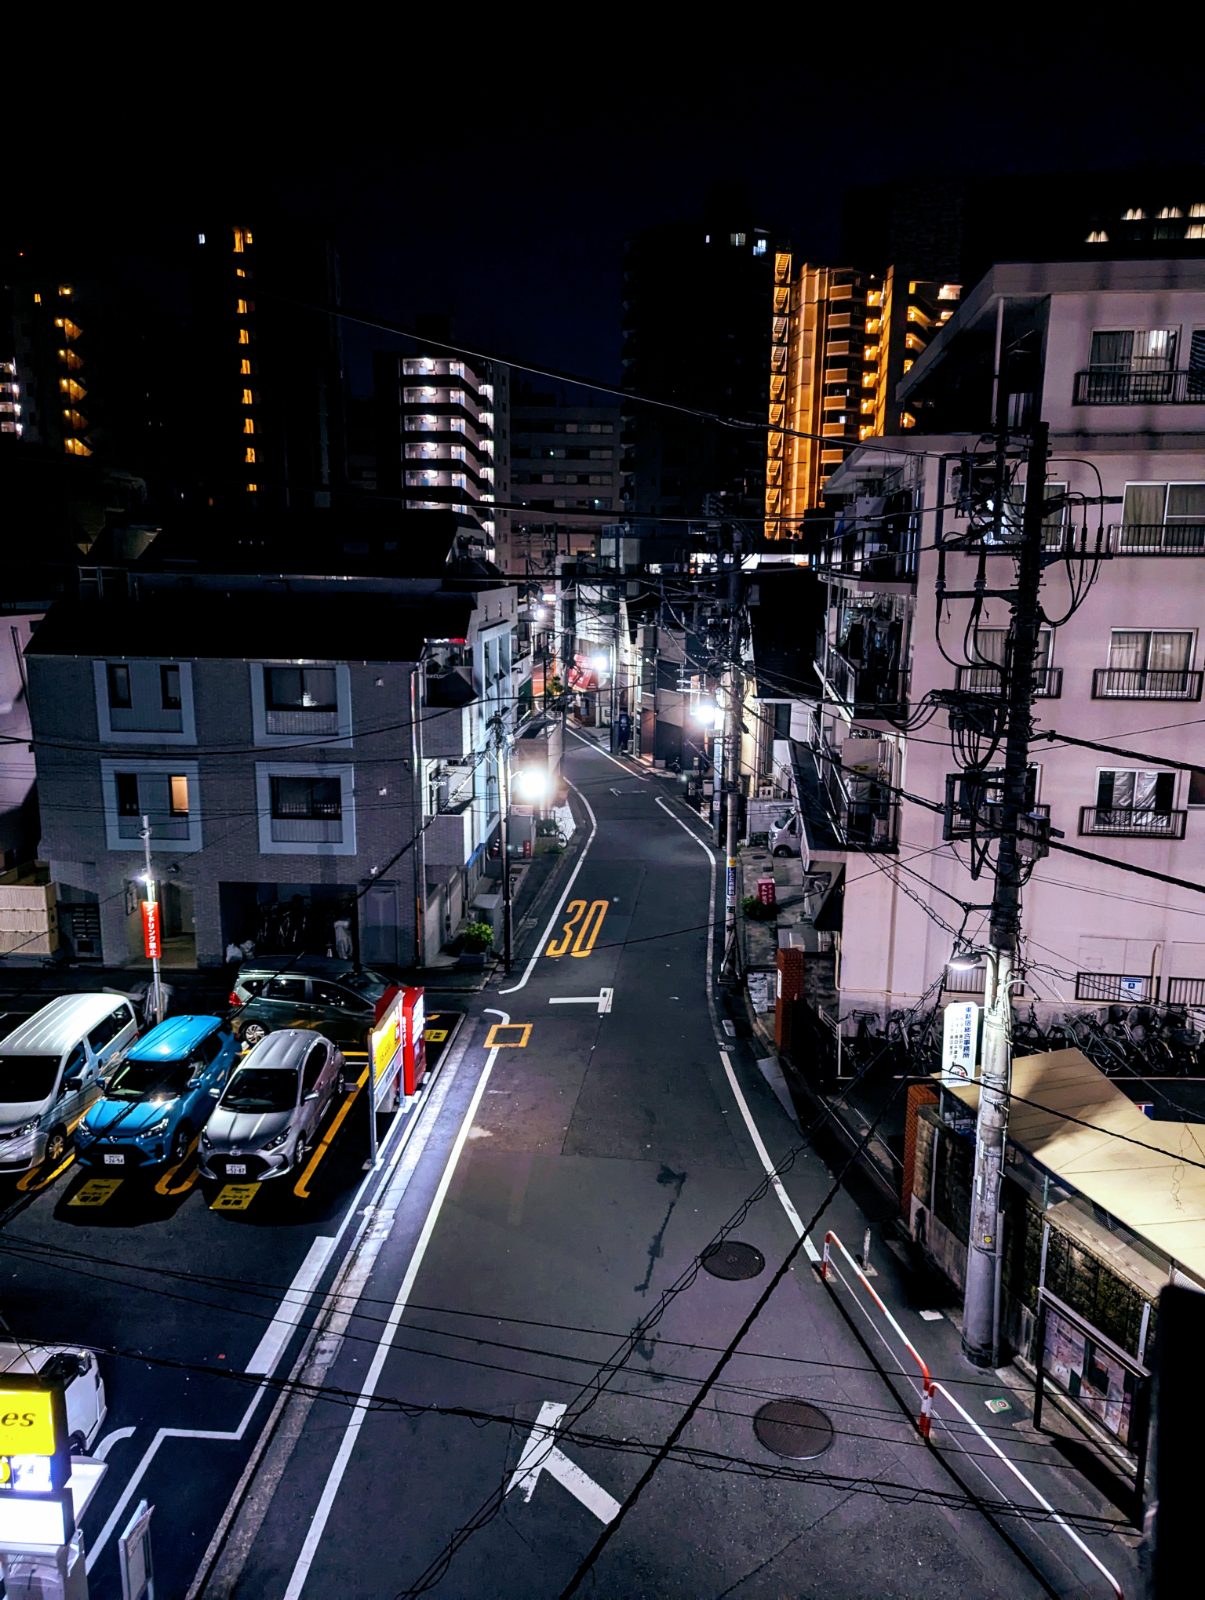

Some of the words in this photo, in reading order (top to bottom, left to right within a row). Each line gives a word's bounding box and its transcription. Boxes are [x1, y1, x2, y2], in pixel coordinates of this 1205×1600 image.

[145, 904, 158, 956] アイドリング禁止
[545, 899, 609, 958] 30
[1, 1412, 36, 1428] es
